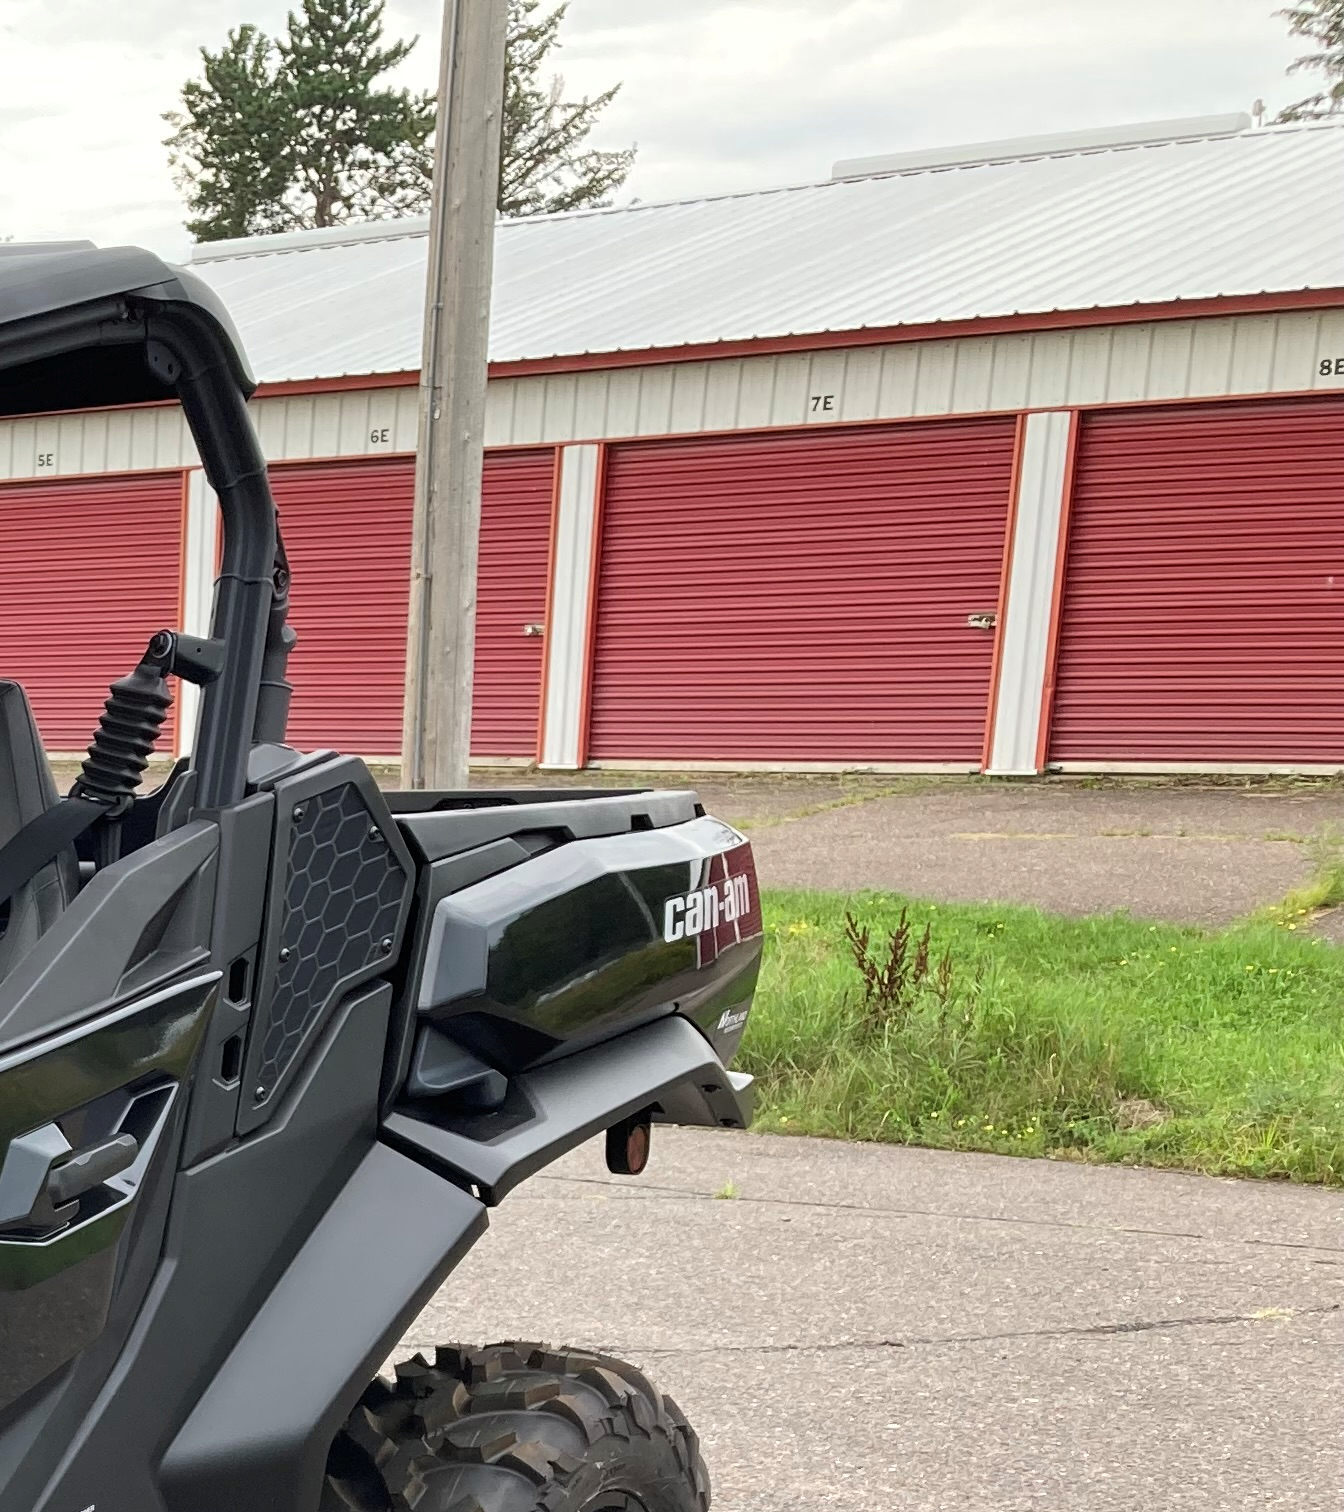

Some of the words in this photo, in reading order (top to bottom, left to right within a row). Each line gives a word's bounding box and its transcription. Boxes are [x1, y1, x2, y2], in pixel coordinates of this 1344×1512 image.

[1319, 358, 1344, 376] 8E
[811, 395, 834, 411] 7E
[370, 429, 389, 443] 6E
[38, 454, 53, 467] 5E
[664, 873, 750, 943] can-am
